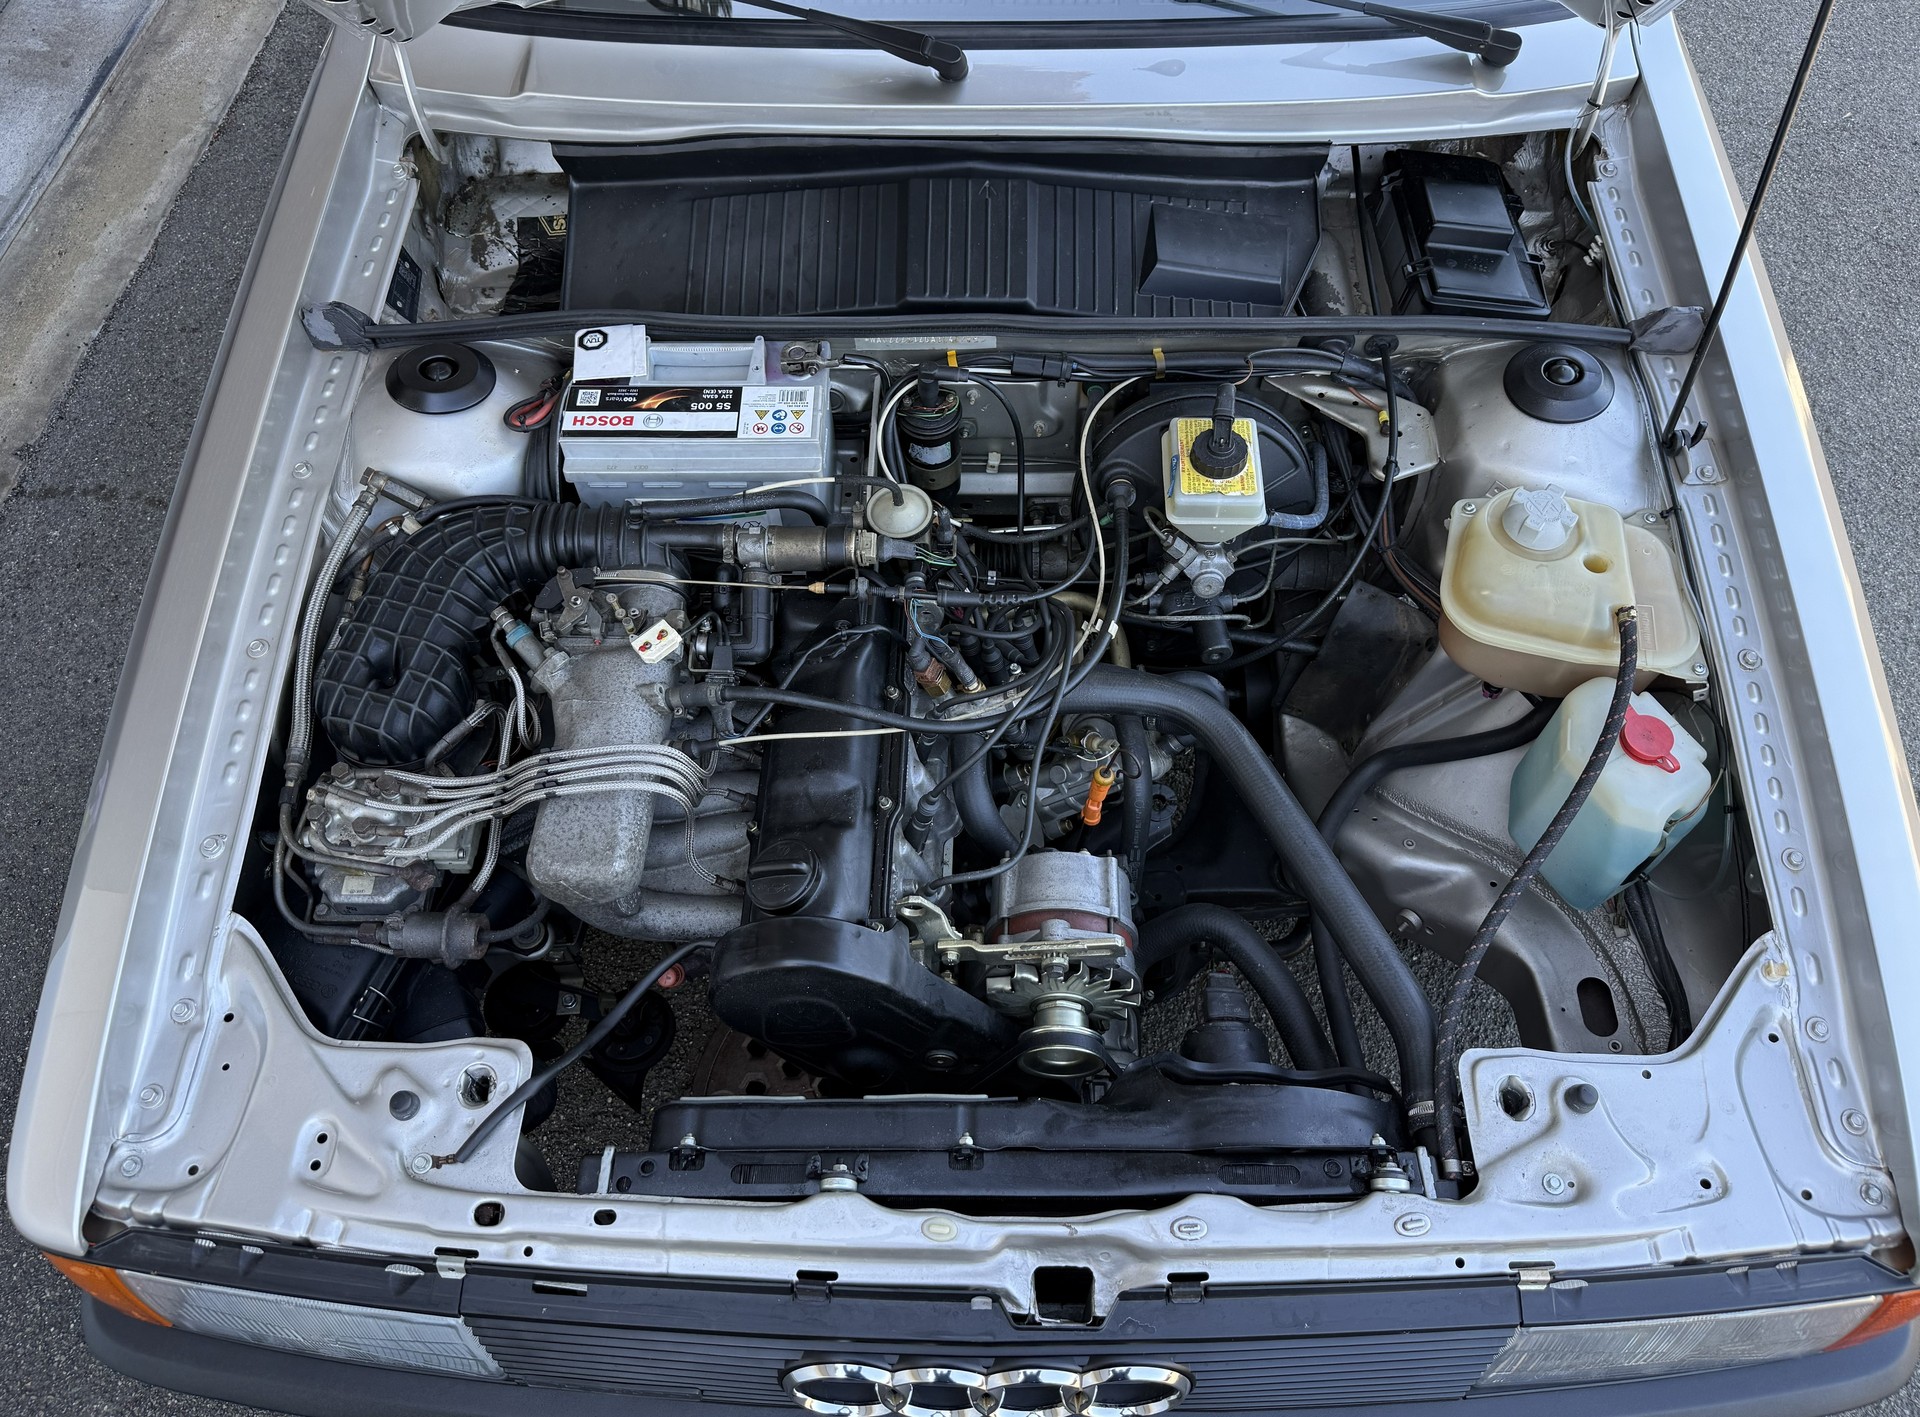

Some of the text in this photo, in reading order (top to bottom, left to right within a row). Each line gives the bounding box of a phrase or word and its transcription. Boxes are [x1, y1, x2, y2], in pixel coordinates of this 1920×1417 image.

[690, 402, 731, 410] S5 005
[572, 415, 635, 427] BOSCH
